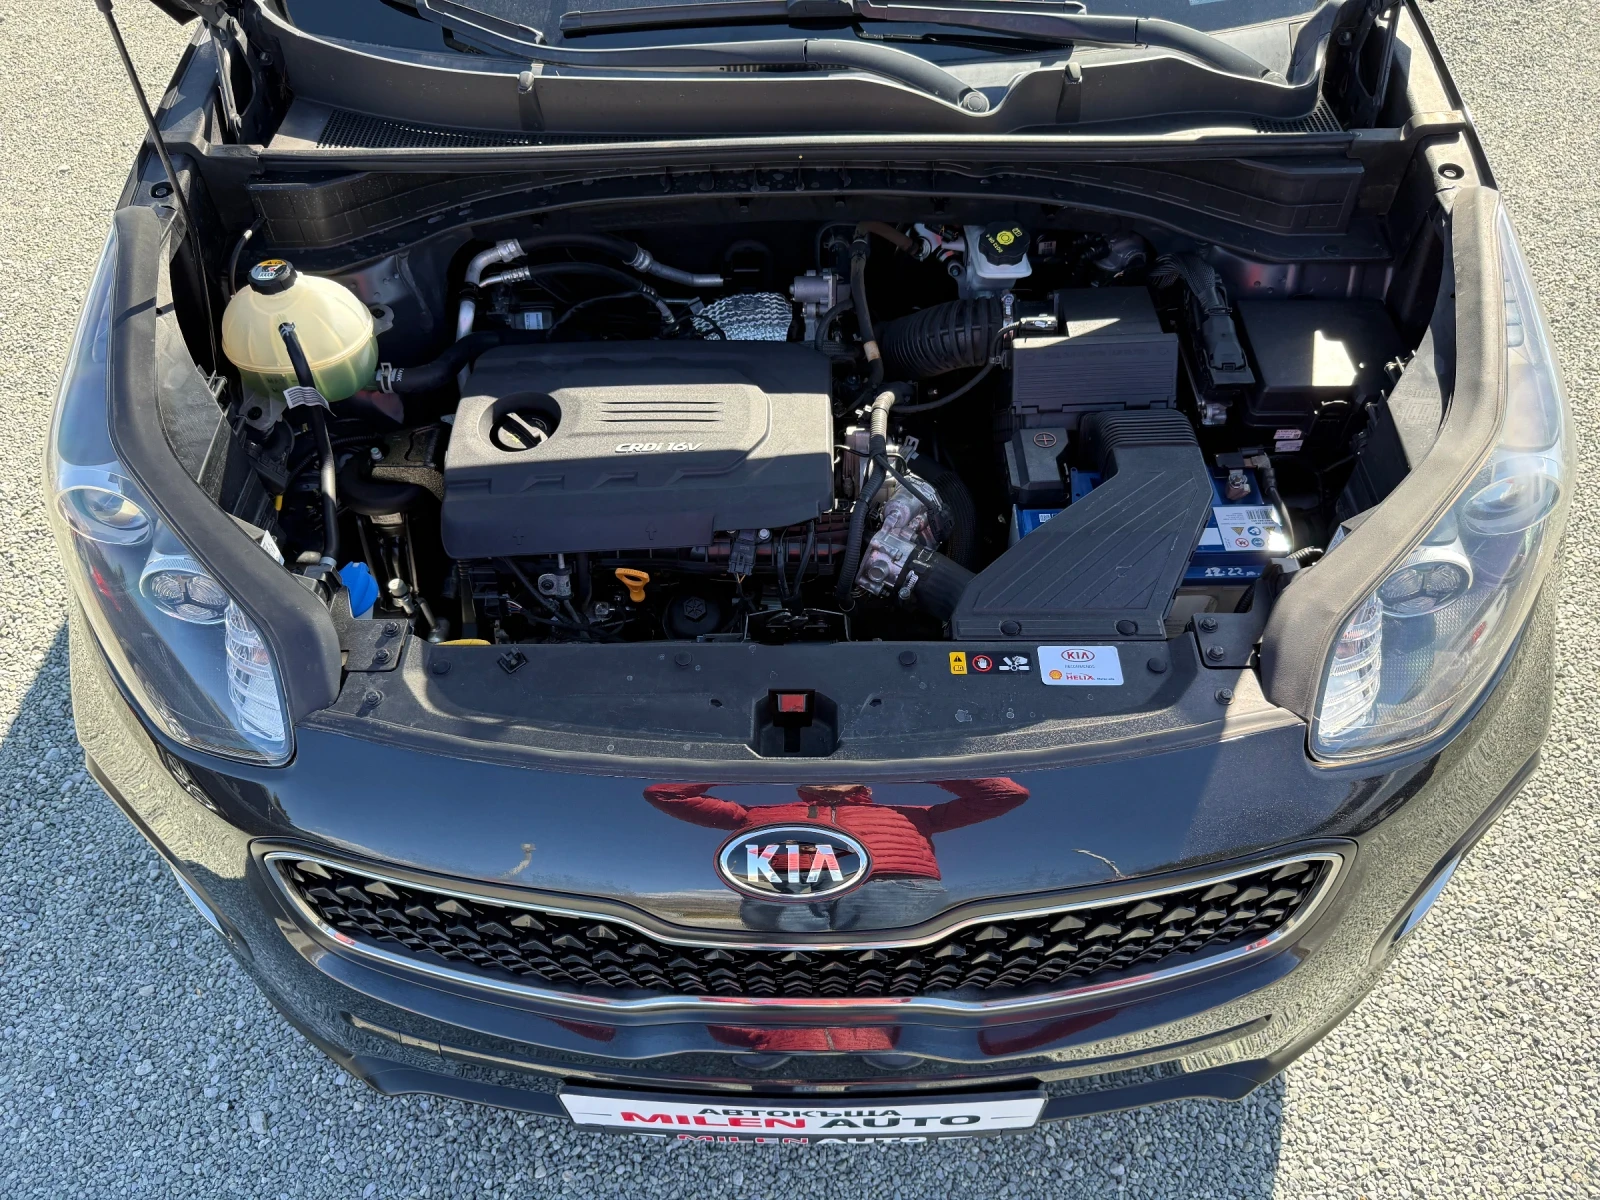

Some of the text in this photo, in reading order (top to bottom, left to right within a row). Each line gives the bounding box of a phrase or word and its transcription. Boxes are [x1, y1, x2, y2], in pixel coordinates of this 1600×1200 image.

[615, 441, 703, 453] CRDi 16V
[1066, 673, 1095, 681] HELIX
[745, 844, 844, 883] KIA
[620, 1111, 981, 1128] MILEN AUTO
